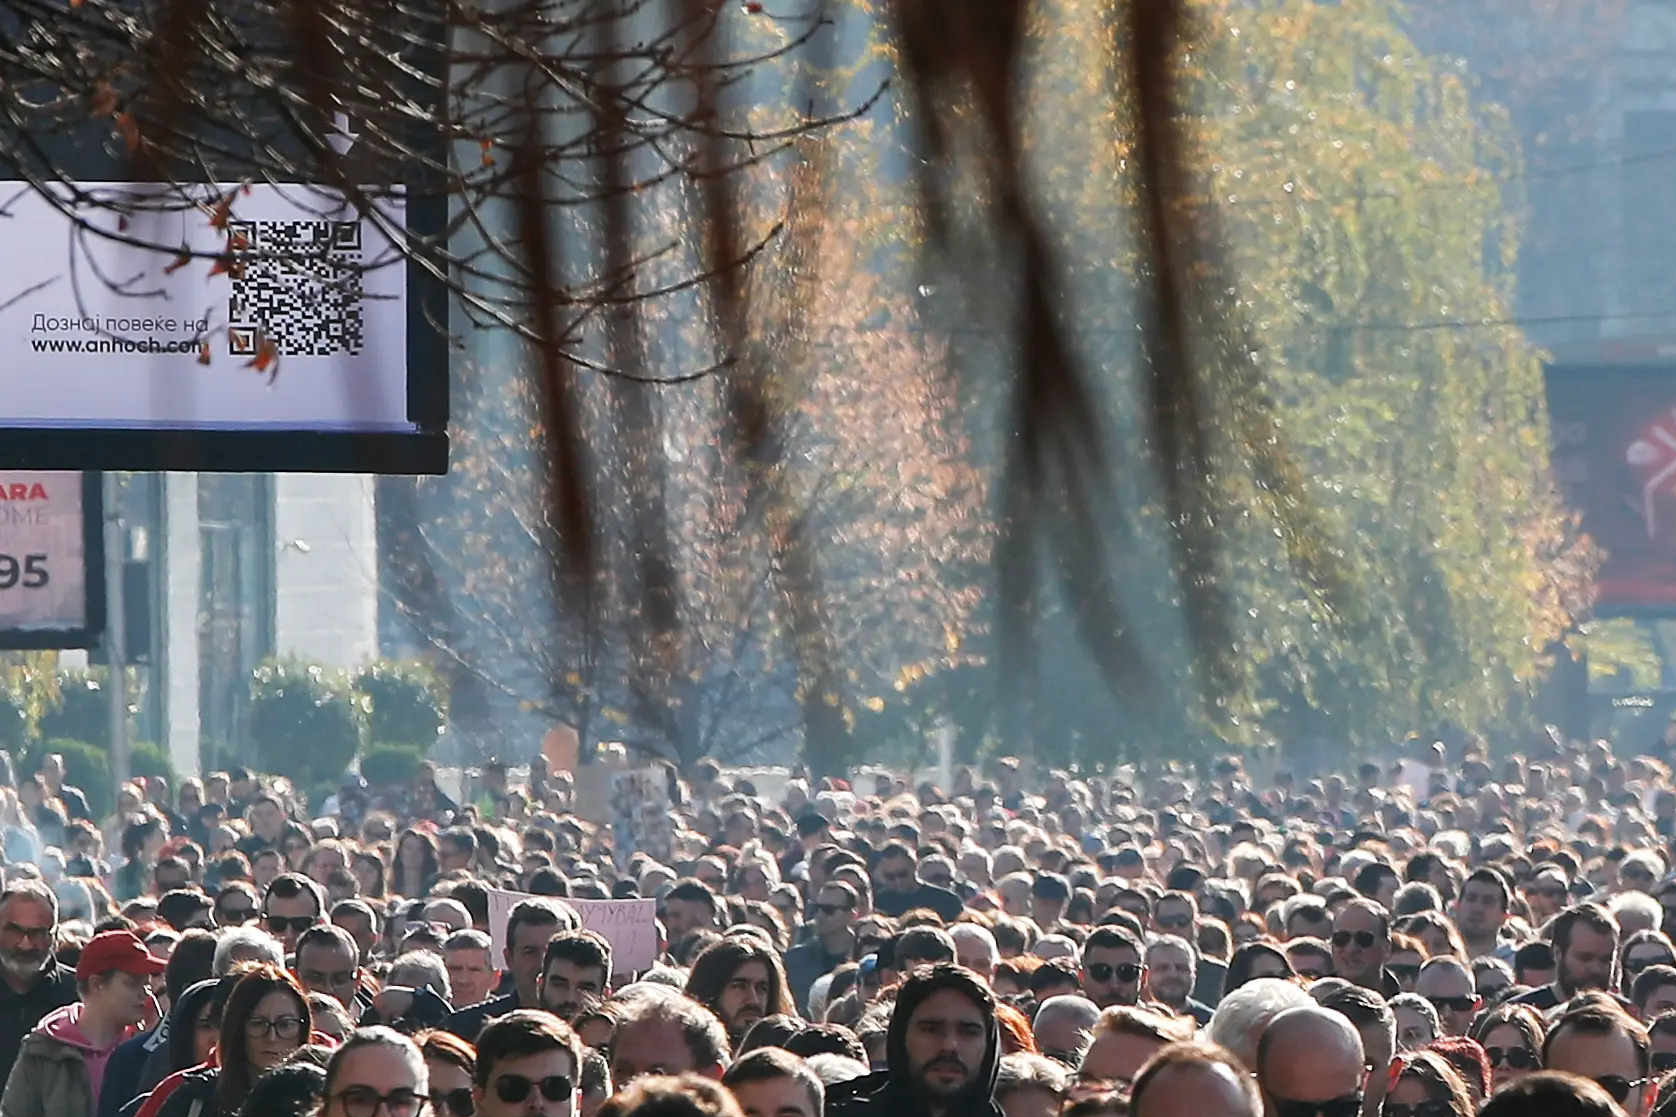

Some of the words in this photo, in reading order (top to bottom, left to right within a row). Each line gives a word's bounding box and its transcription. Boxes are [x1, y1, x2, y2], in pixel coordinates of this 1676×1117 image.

[31, 313, 100, 335] Дознај
[106, 315, 178, 332] повеќе
[183, 318, 209, 333] на
